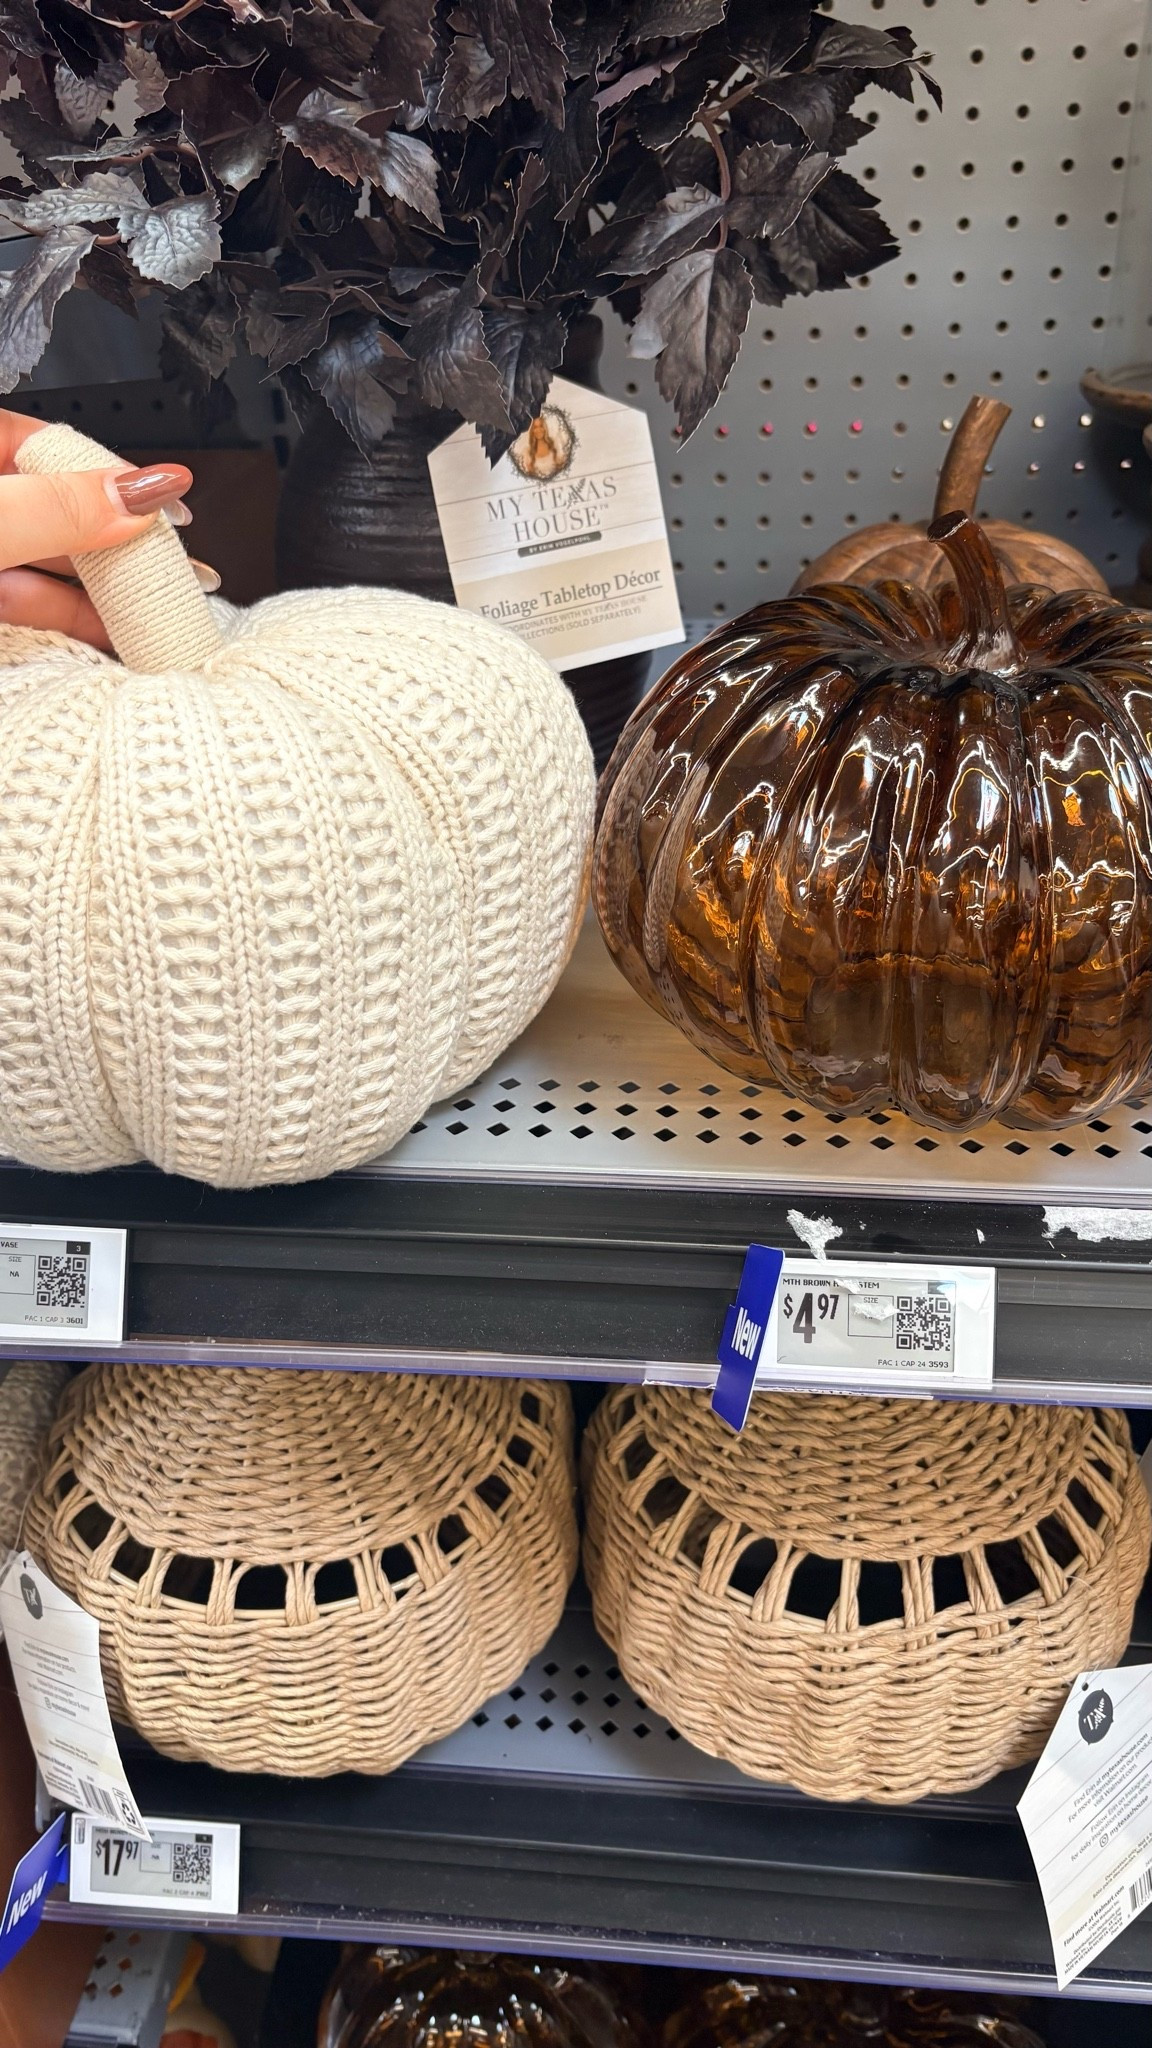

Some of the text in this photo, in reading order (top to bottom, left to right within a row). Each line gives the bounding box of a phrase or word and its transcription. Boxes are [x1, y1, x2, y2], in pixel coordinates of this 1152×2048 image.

[486, 476, 617, 522] MY TEXAS
[480, 569, 661, 620] Foliage Tabletop Décor
[560, 610, 580, 622] WITH
[782, 1278, 801, 1286] MTH
[803, 1279, 831, 1287] BROWN
[731, 1307, 761, 1360] New
[1073, 1793, 1086, 1807] Find
[6, 1871, 48, 1935] New
[1064, 1933, 1075, 1947] Find
[1075, 1922, 1088, 1936] more
[1094, 1885, 1125, 1918] Walmart.com
